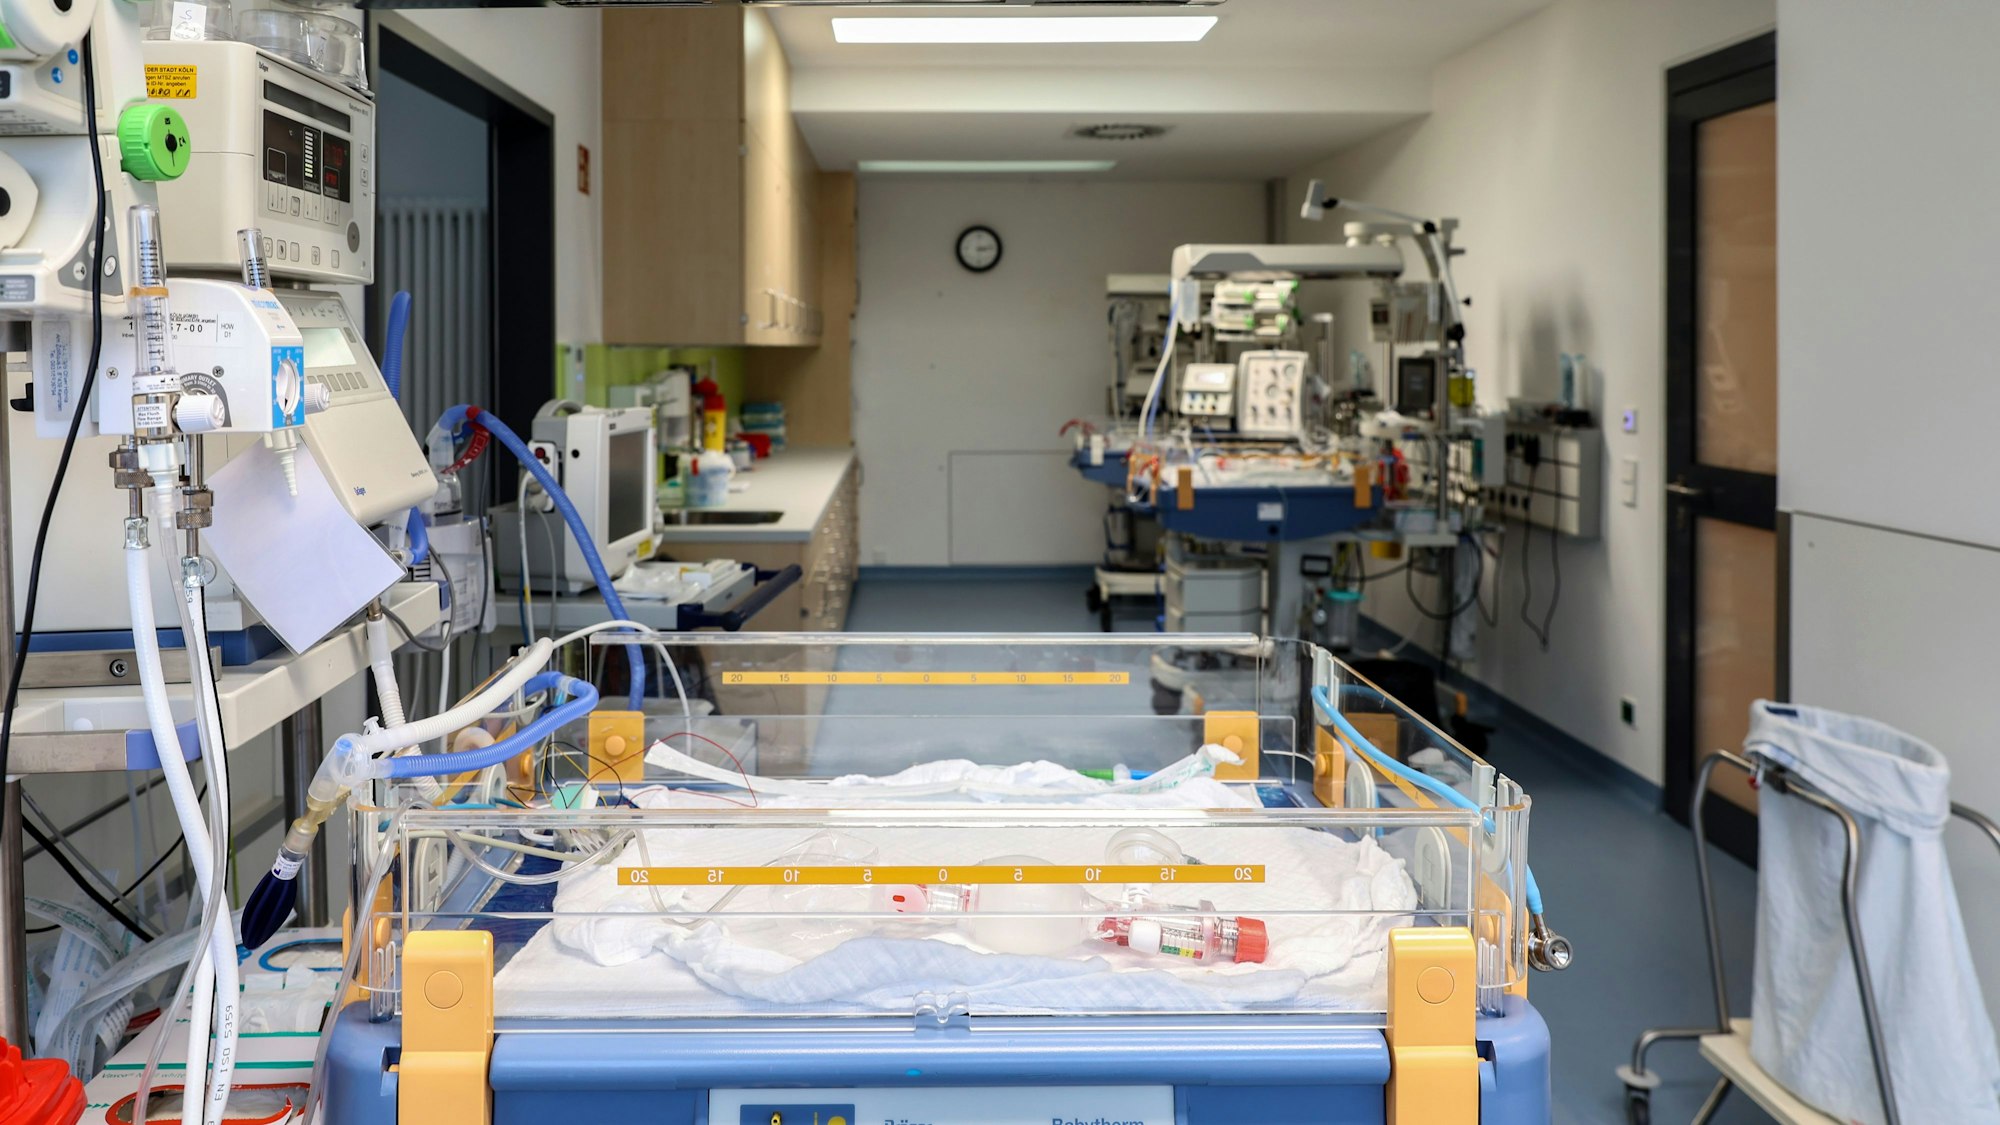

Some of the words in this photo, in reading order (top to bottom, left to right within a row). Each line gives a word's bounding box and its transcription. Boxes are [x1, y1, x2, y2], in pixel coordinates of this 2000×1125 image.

[198, 375, 216, 387] OUTLET
[731, 674, 742, 682] 20
[779, 674, 790, 682] 15
[827, 674, 837, 682] 10
[876, 674, 882, 682] 5
[923, 674, 929, 682] 0
[971, 674, 977, 682] 5
[1016, 674, 1026, 682] 10
[1063, 674, 1073, 682] 15
[1109, 674, 1121, 682] 20
[224, 1005, 233, 1039] 5359
[220, 1048, 230, 1073] ISO
[214, 1083, 225, 1101] EN
